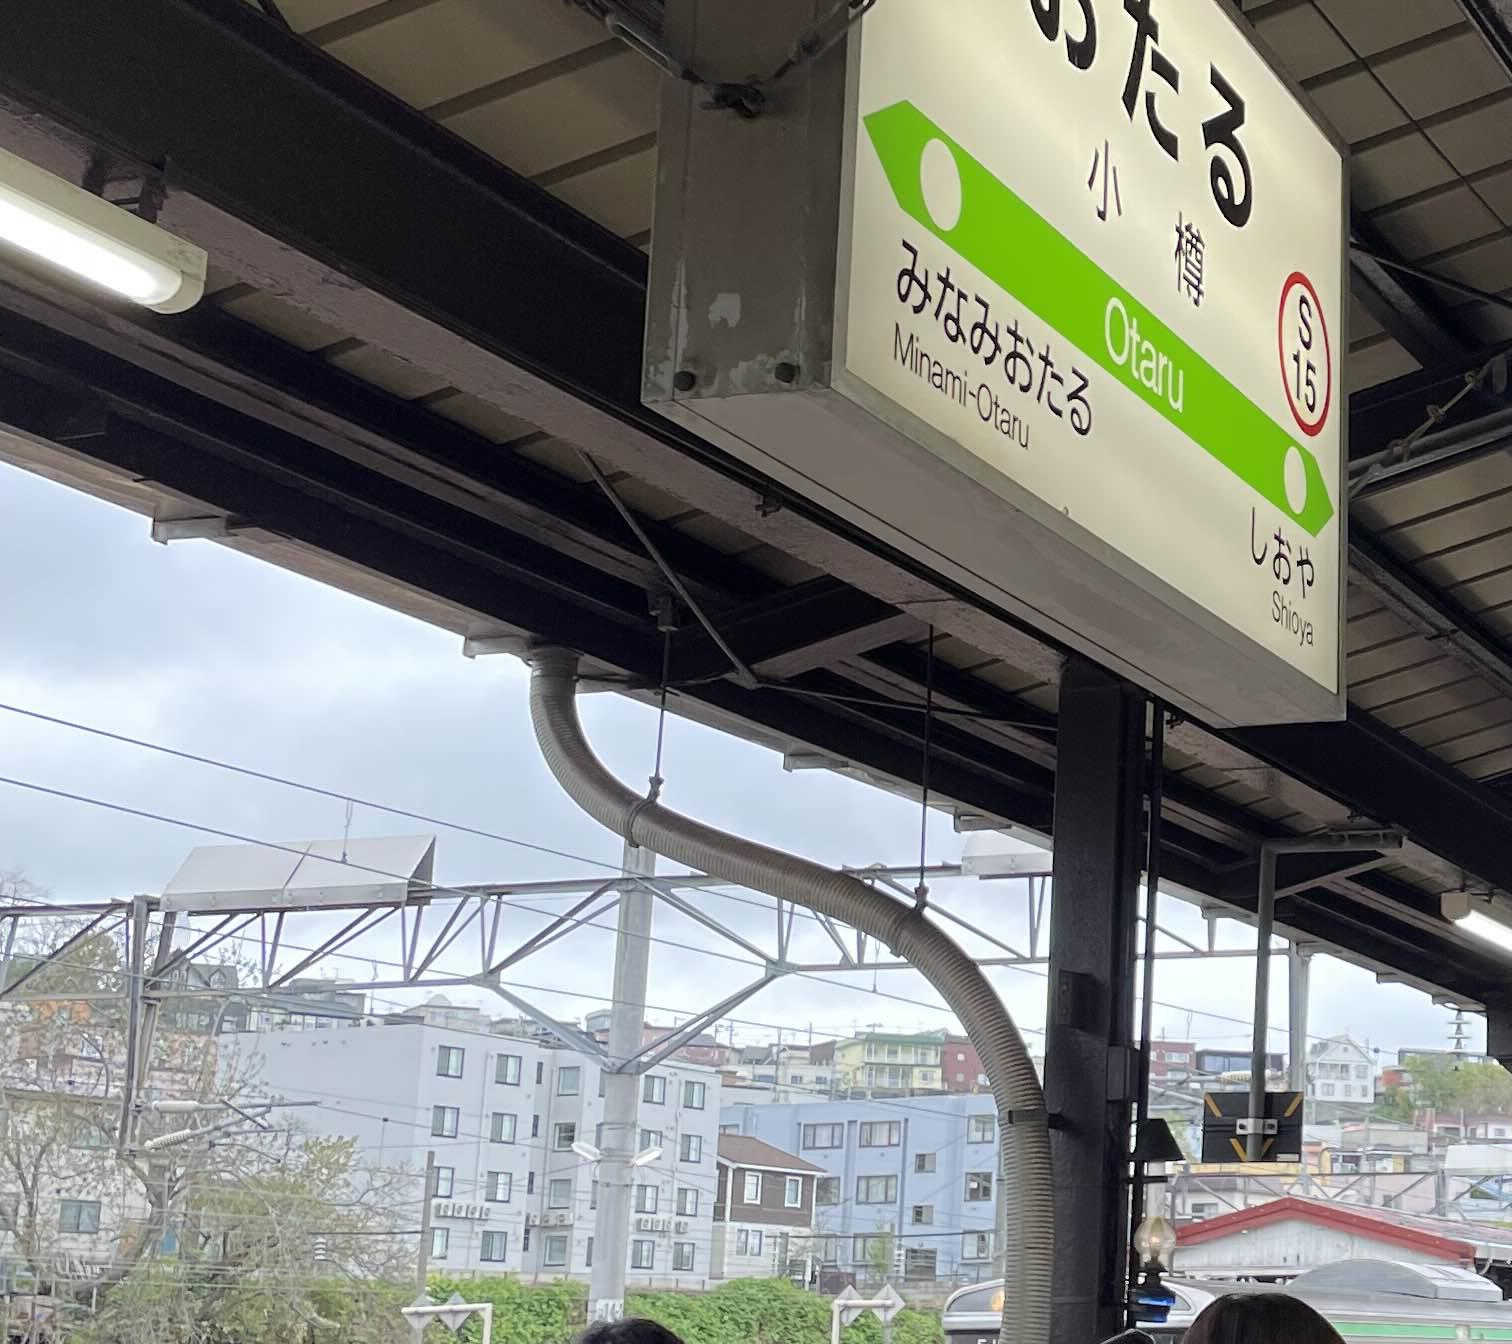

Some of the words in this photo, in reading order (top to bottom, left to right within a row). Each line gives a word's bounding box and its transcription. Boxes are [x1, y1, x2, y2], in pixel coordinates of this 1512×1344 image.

[1087, 138, 1205, 308] 小樽
[896, 238, 1094, 436] みなみおたる
[1104, 296, 1185, 414] Otaru
[1298, 294, 1313, 351] S
[893, 319, 1031, 451] Minami-Otaru
[1292, 350, 1317, 414] 15
[1251, 506, 1315, 600] しおや
[1271, 589, 1315, 648] Shioya
